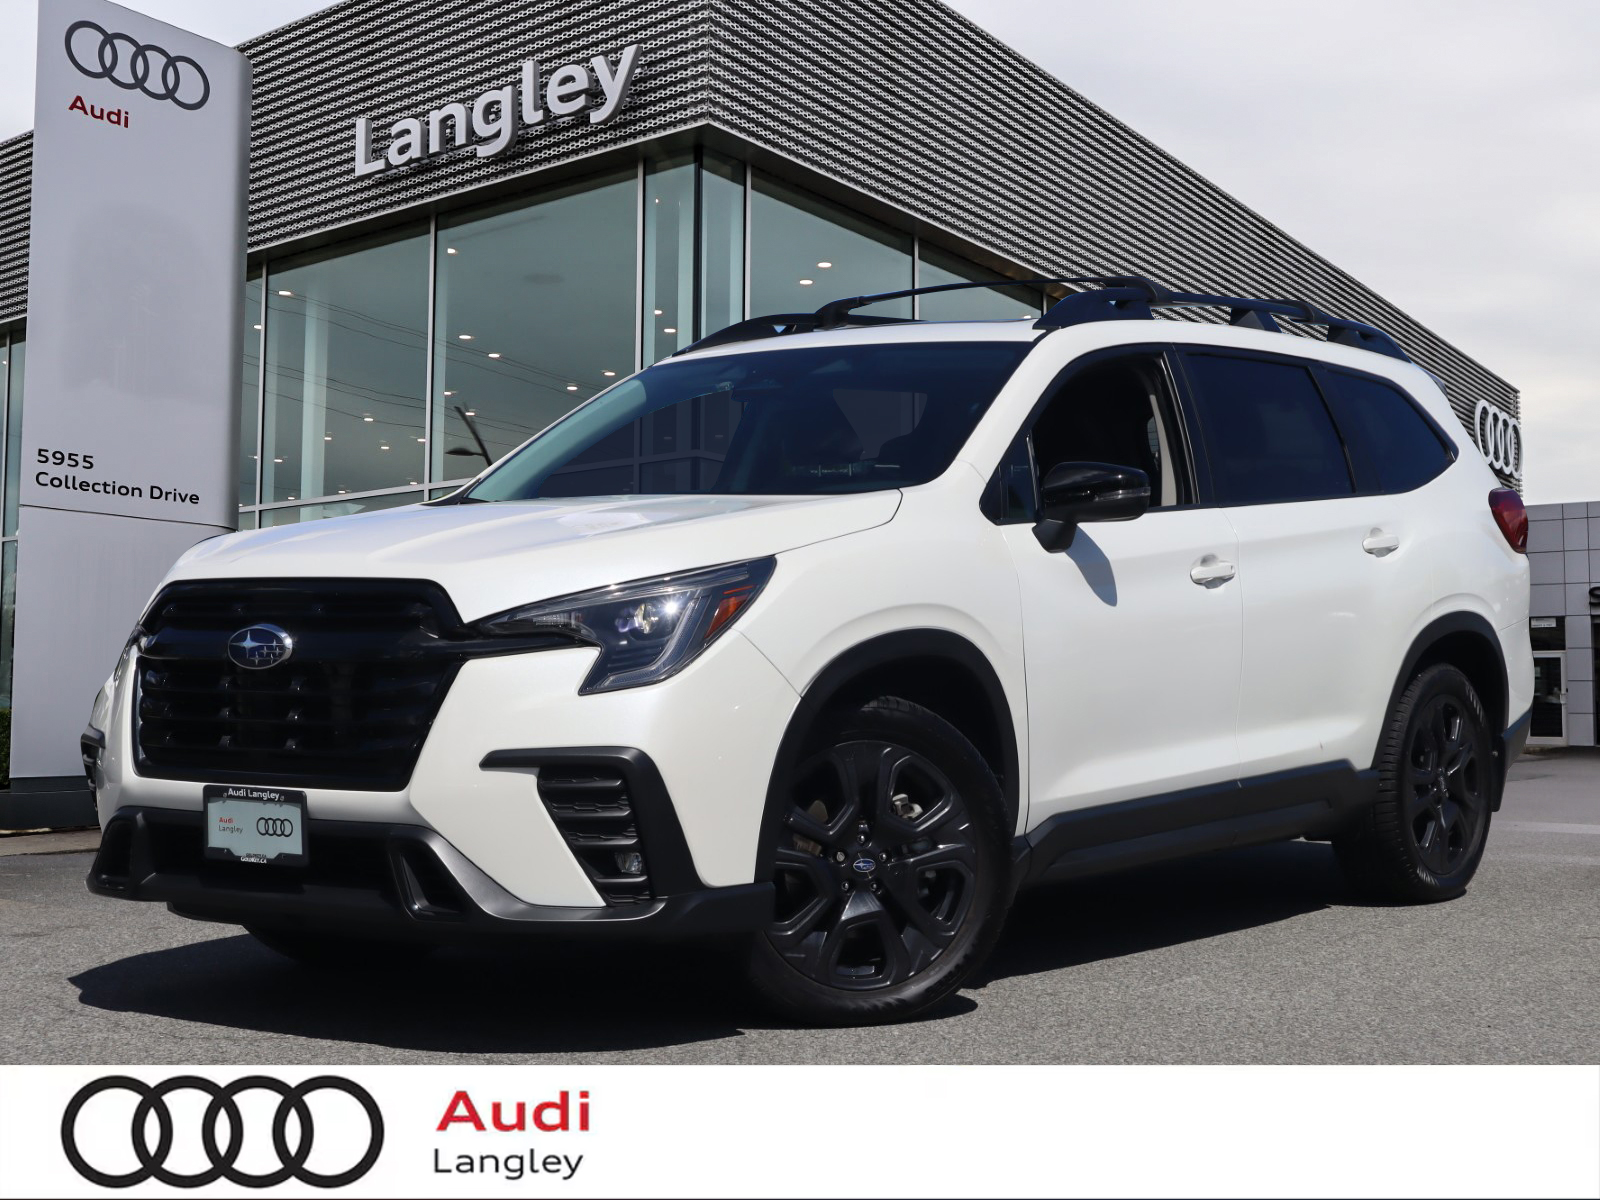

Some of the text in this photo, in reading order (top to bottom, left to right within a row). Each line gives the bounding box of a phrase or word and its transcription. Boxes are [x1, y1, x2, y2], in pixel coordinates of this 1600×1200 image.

[68, 95, 129, 129] Audi
[355, 43, 642, 177] Langley
[37, 448, 95, 470] 5955
[35, 471, 200, 505] Collection Drive
[228, 788, 280, 801] Audi Langley
[218, 824, 244, 834] Langley
